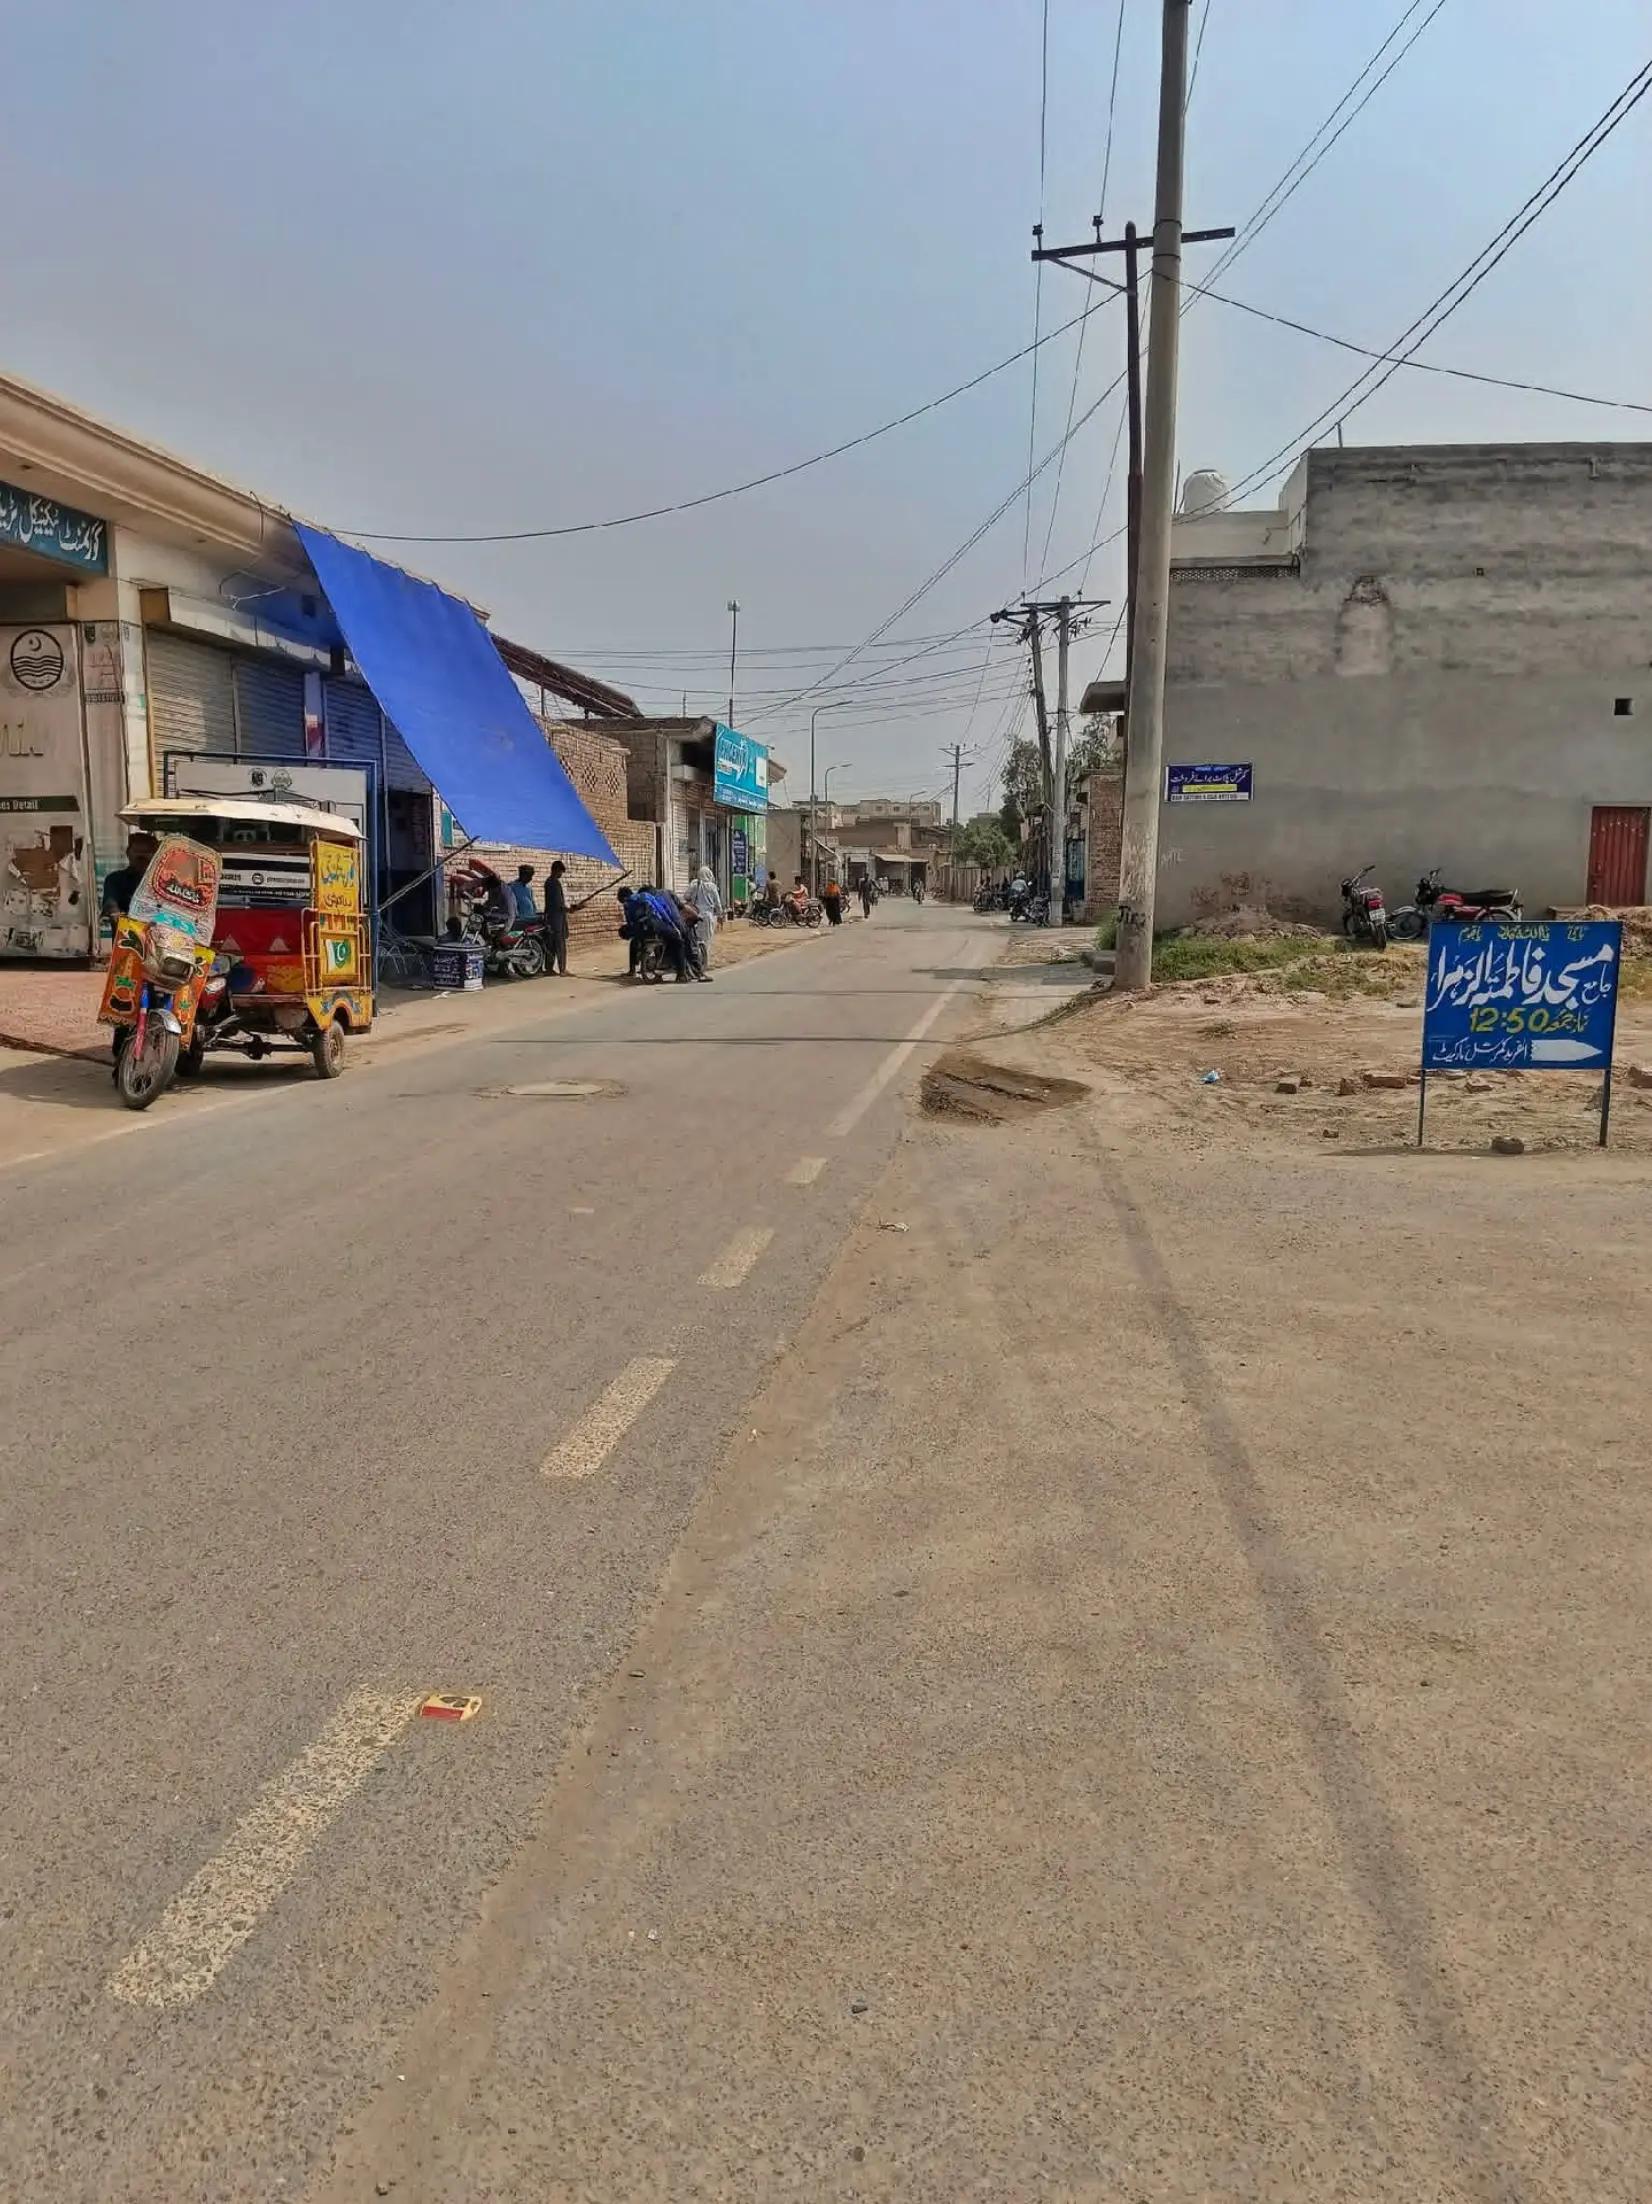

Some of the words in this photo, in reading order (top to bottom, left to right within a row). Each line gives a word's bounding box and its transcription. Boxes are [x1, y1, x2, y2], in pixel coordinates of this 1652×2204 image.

[59, 517, 104, 561] گورنمنٹ
[12, 799, 39, 810] Detail
[1522, 943, 1615, 1010] مسجد
[1580, 964, 1612, 1006] جامع
[1470, 1007, 1550, 1034] 12:50
[1432, 1036, 1468, 1062] مارکیٹ
